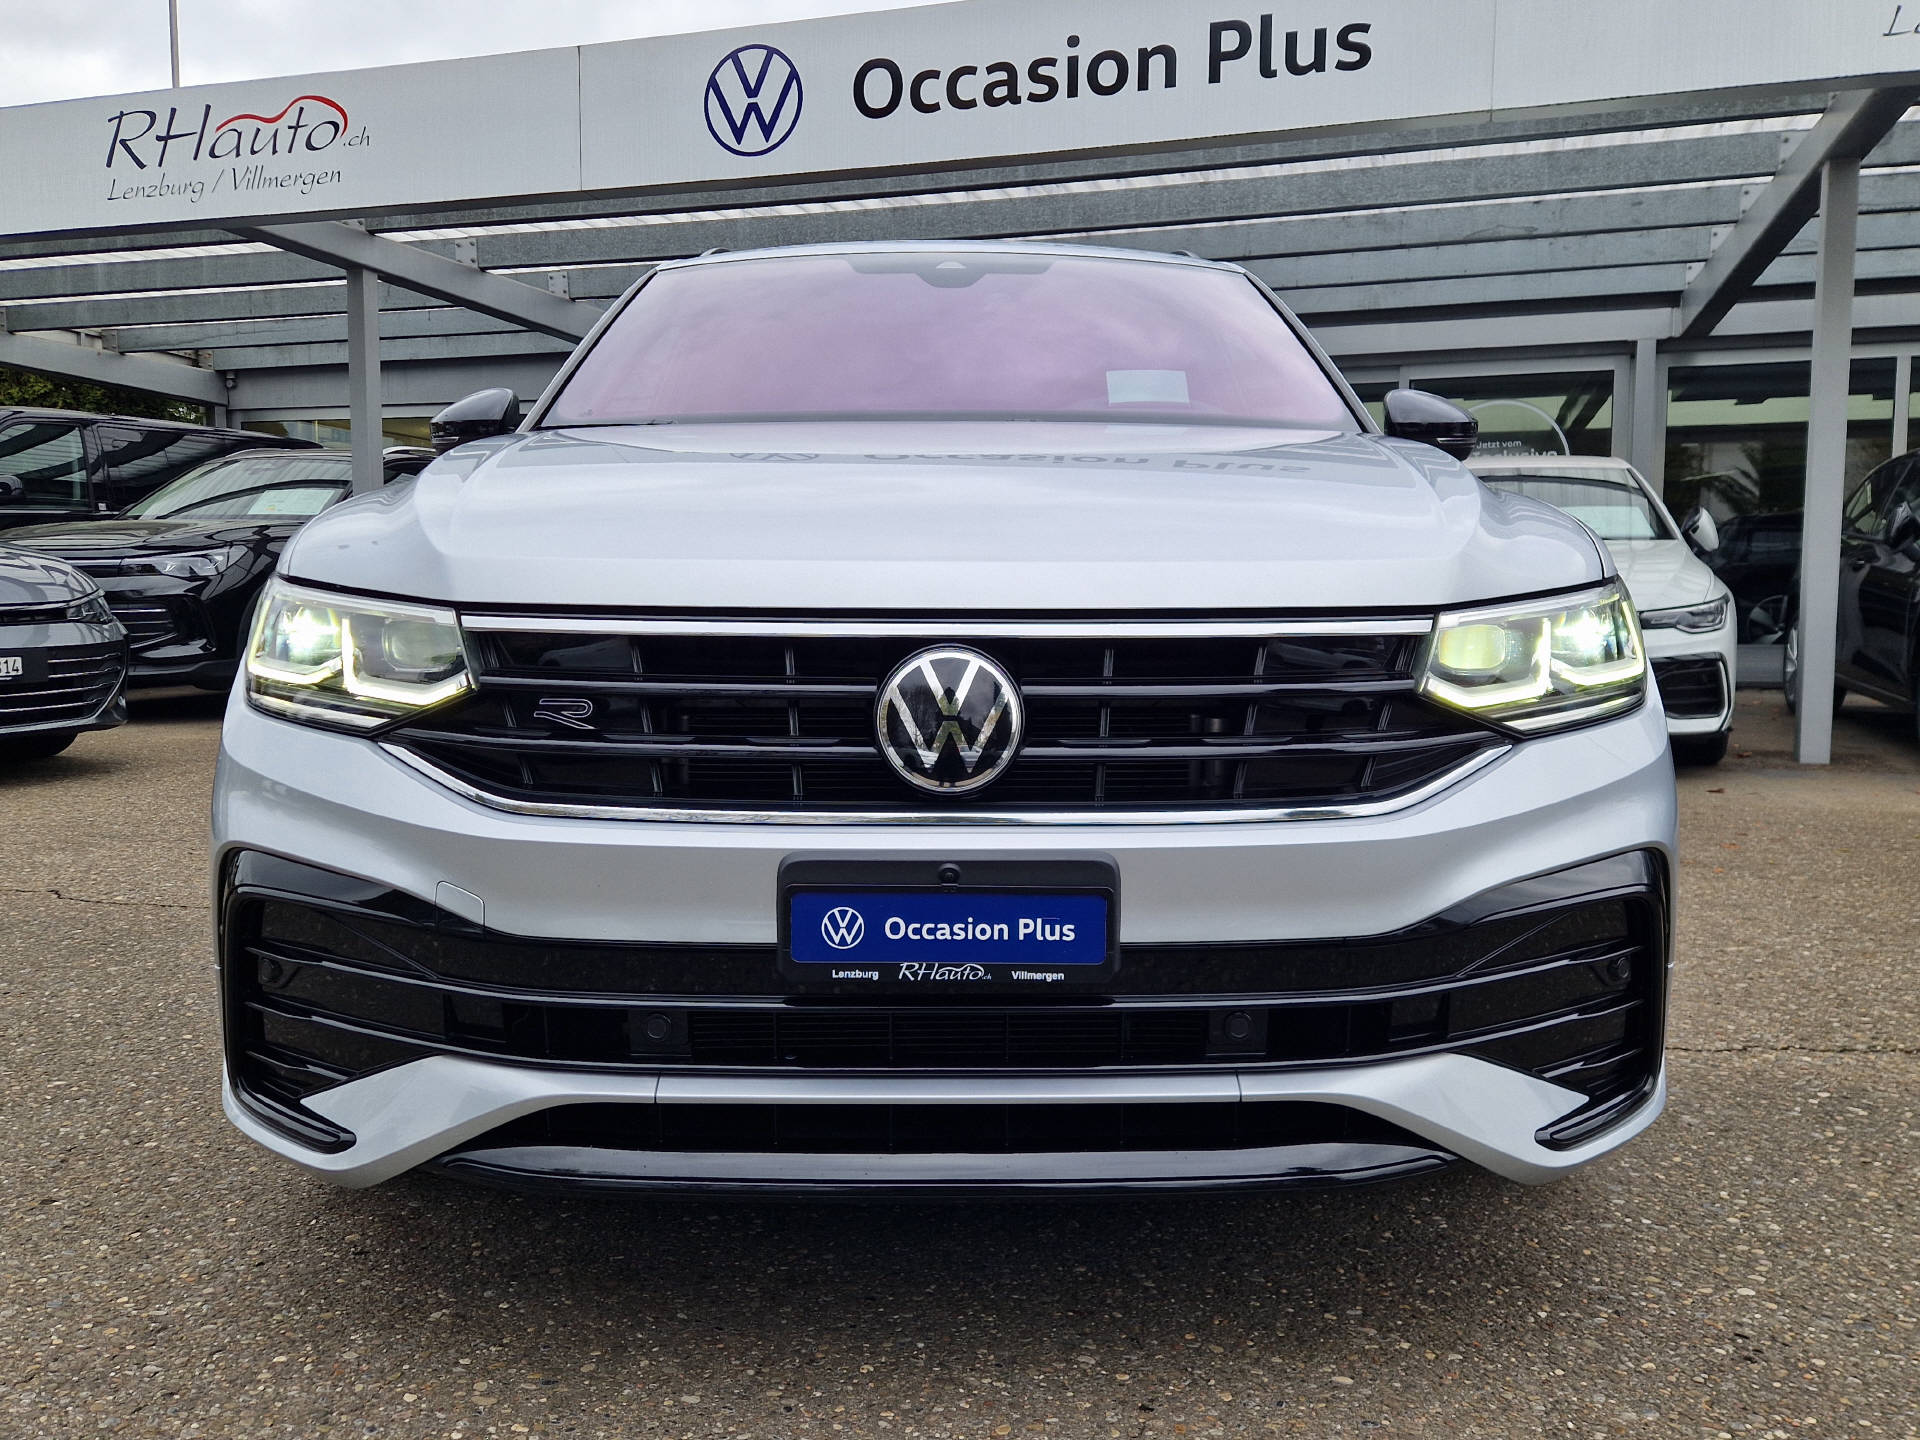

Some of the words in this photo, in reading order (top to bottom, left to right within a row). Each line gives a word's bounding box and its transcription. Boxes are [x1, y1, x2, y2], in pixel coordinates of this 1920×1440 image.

[853, 35, 1177, 120] Occasion
[1208, 13, 1372, 85] Plus
[107, 171, 204, 203] Lenzburg
[231, 164, 342, 195] Villmergen
[1476, 441, 1500, 450] Jetzt
[1502, 440, 1522, 448] vom
[0, 658, 20, 674] 14
[884, 917, 1009, 941] Occasion
[1018, 917, 1076, 941] Plus
[832, 969, 879, 981] Lenzburg
[1011, 970, 1065, 982] Villmergen
